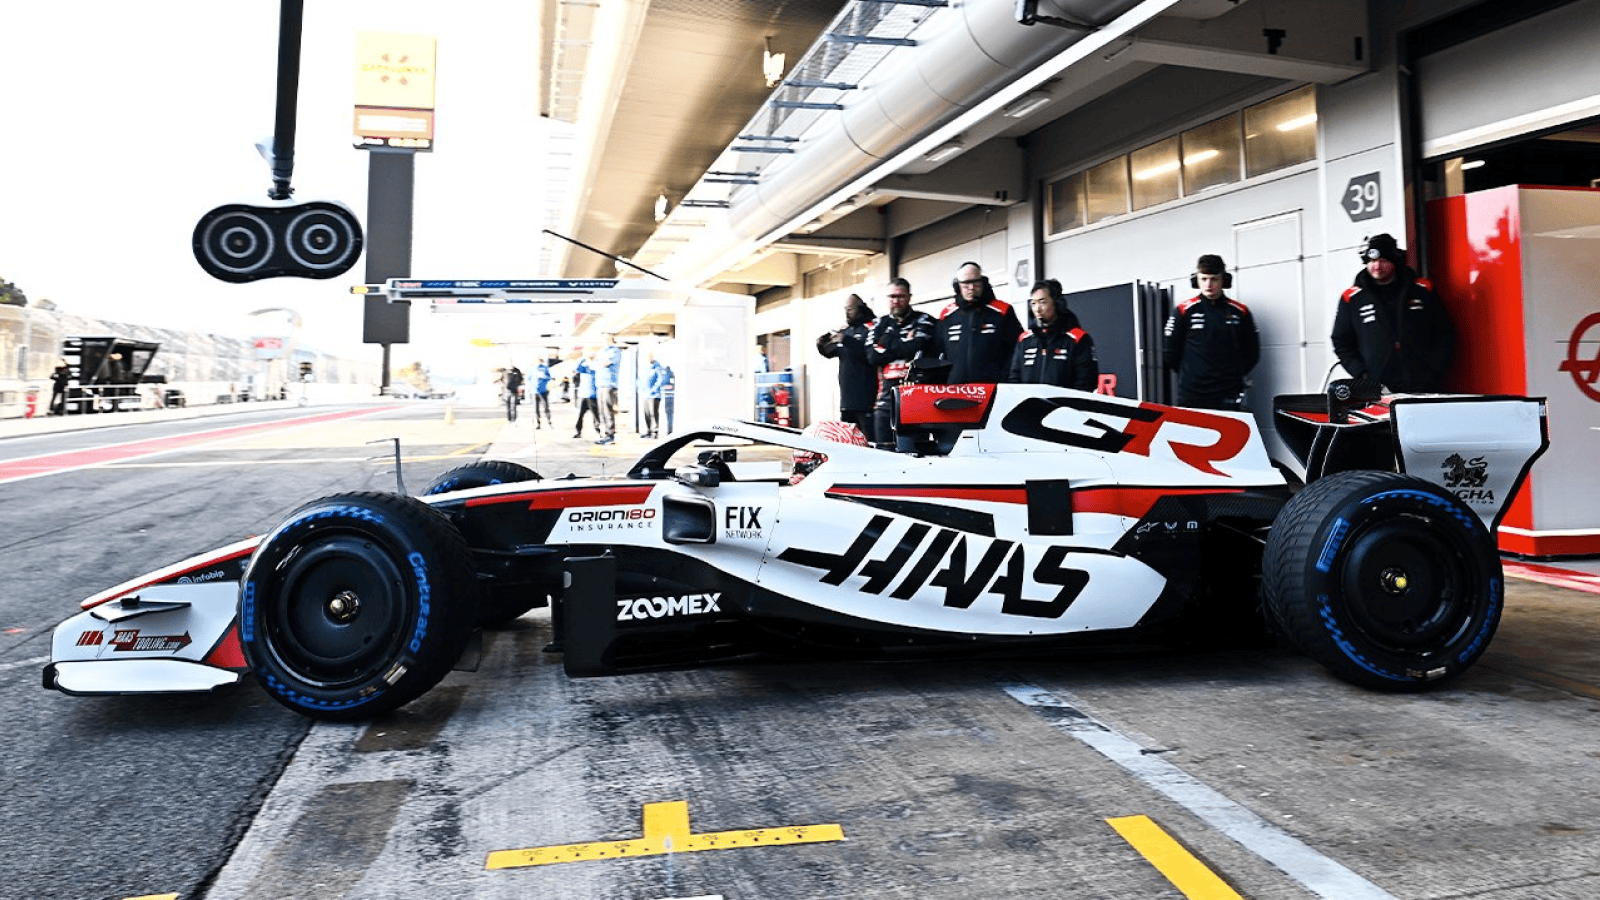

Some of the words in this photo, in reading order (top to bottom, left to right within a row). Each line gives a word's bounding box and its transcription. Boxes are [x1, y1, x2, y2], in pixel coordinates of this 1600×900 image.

[1350, 181, 1378, 214] 39
[924, 385, 986, 395] RUCKUS
[1001, 397, 1251, 477] GR
[1452, 489, 1495, 500] GHA
[569, 508, 655, 523] ORION180
[725, 507, 762, 529] FIX
[570, 521, 653, 531] INSURANCE
[725, 530, 762, 539] NETWORK
[776, 514, 1090, 619] HAAS
[192, 570, 225, 584] infobip
[617, 592, 721, 621] ZOOMEX
